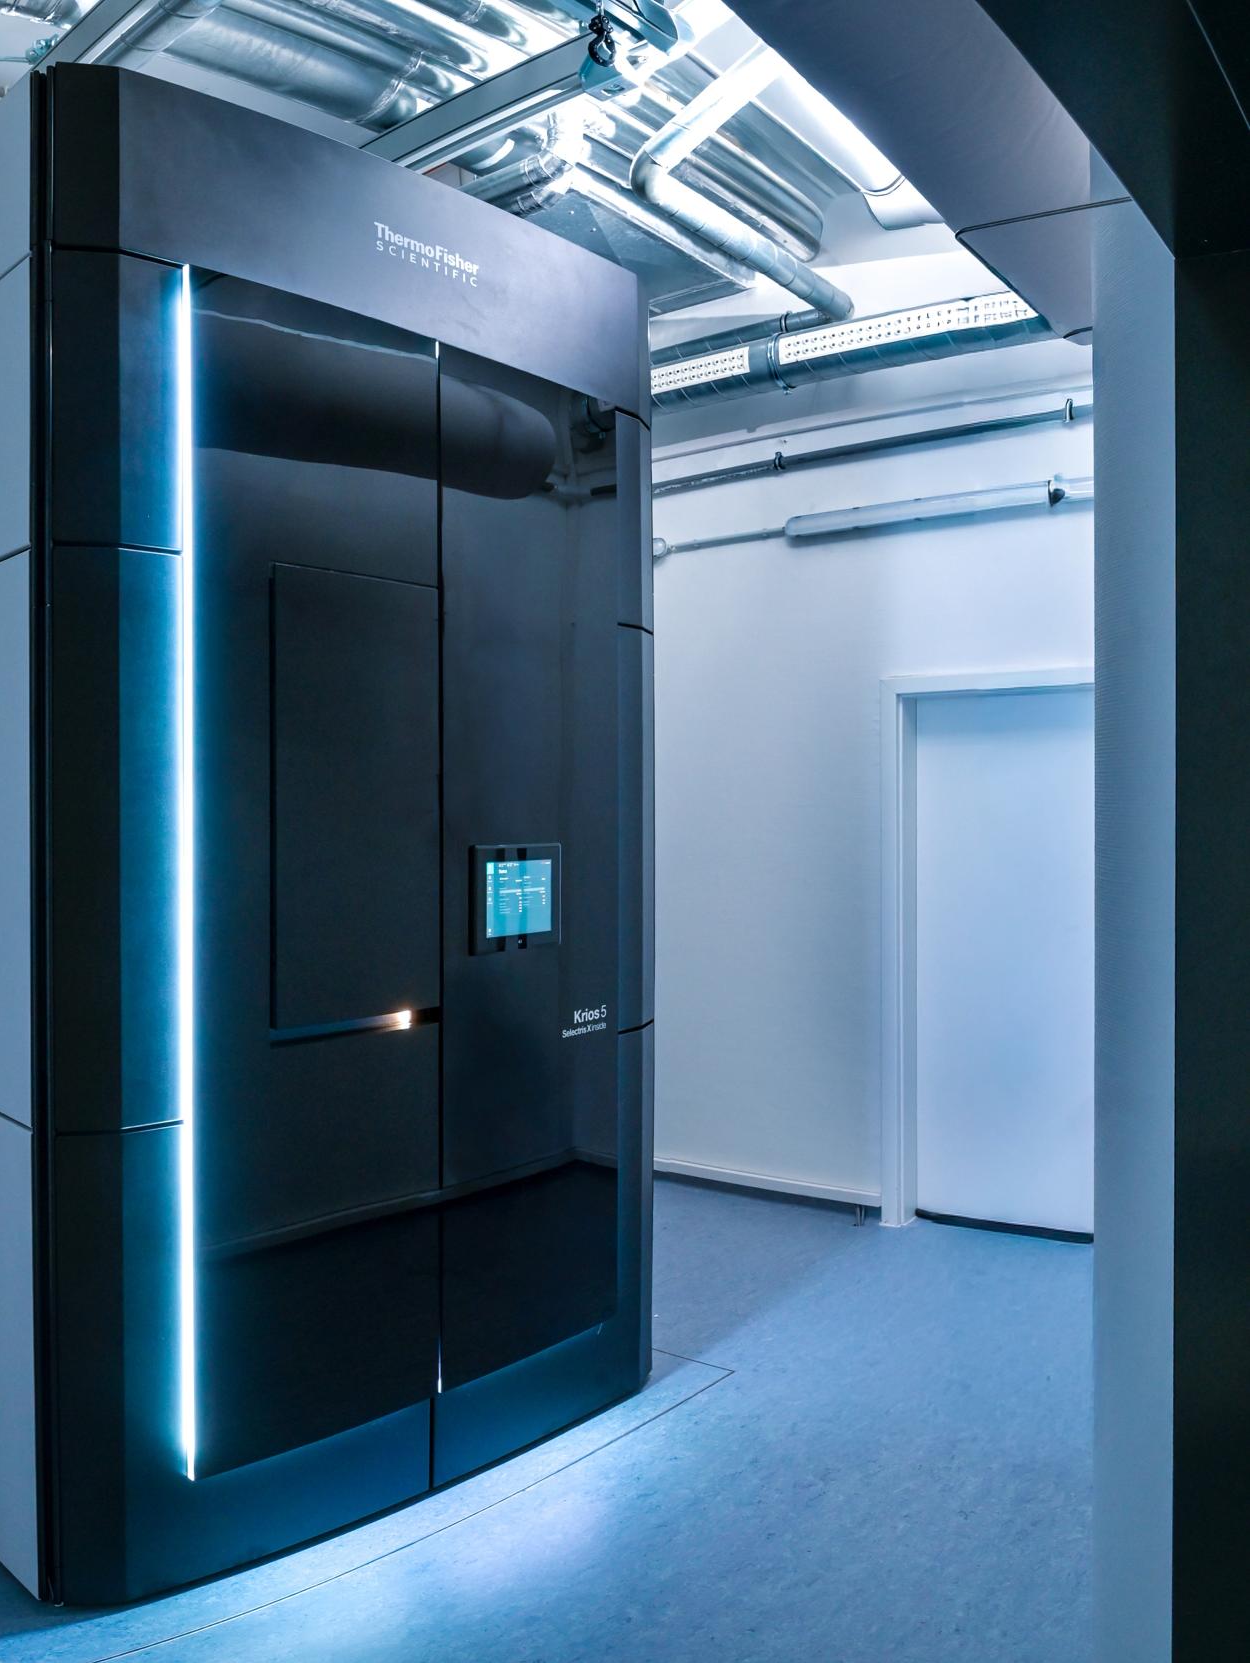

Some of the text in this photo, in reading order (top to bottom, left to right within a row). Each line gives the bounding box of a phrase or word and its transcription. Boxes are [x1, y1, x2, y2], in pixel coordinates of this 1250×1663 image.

[376, 241, 478, 287] SCIENTIFIC
[573, 1004, 607, 1024] Krios 5
[562, 1026, 587, 1039] Selectris
[591, 1022, 607, 1031] inside
